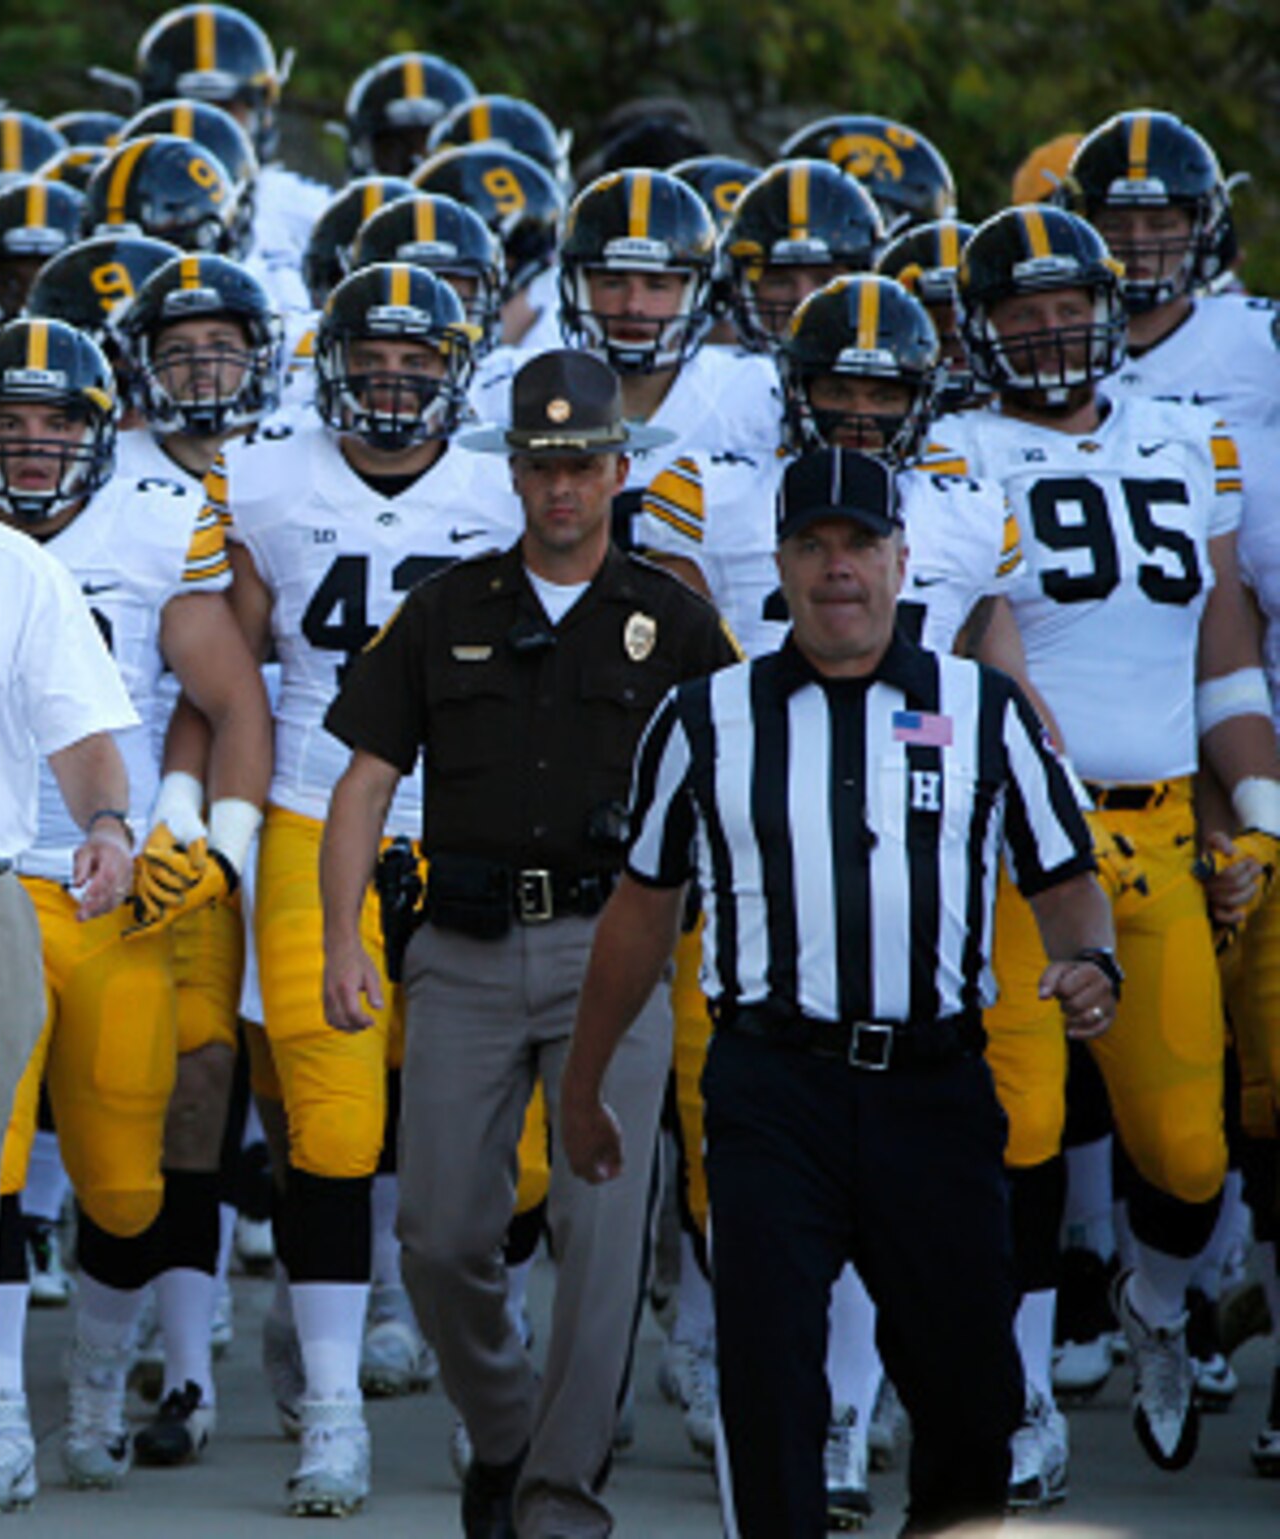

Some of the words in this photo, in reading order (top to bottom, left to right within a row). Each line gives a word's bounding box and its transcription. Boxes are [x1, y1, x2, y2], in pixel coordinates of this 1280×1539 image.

[188, 158, 224, 204] 9
[482, 168, 526, 215] 9
[90, 262, 134, 313] 9
[1028, 477, 1203, 606] 95
[301, 556, 462, 690] 4
[912, 771, 940, 811] H
